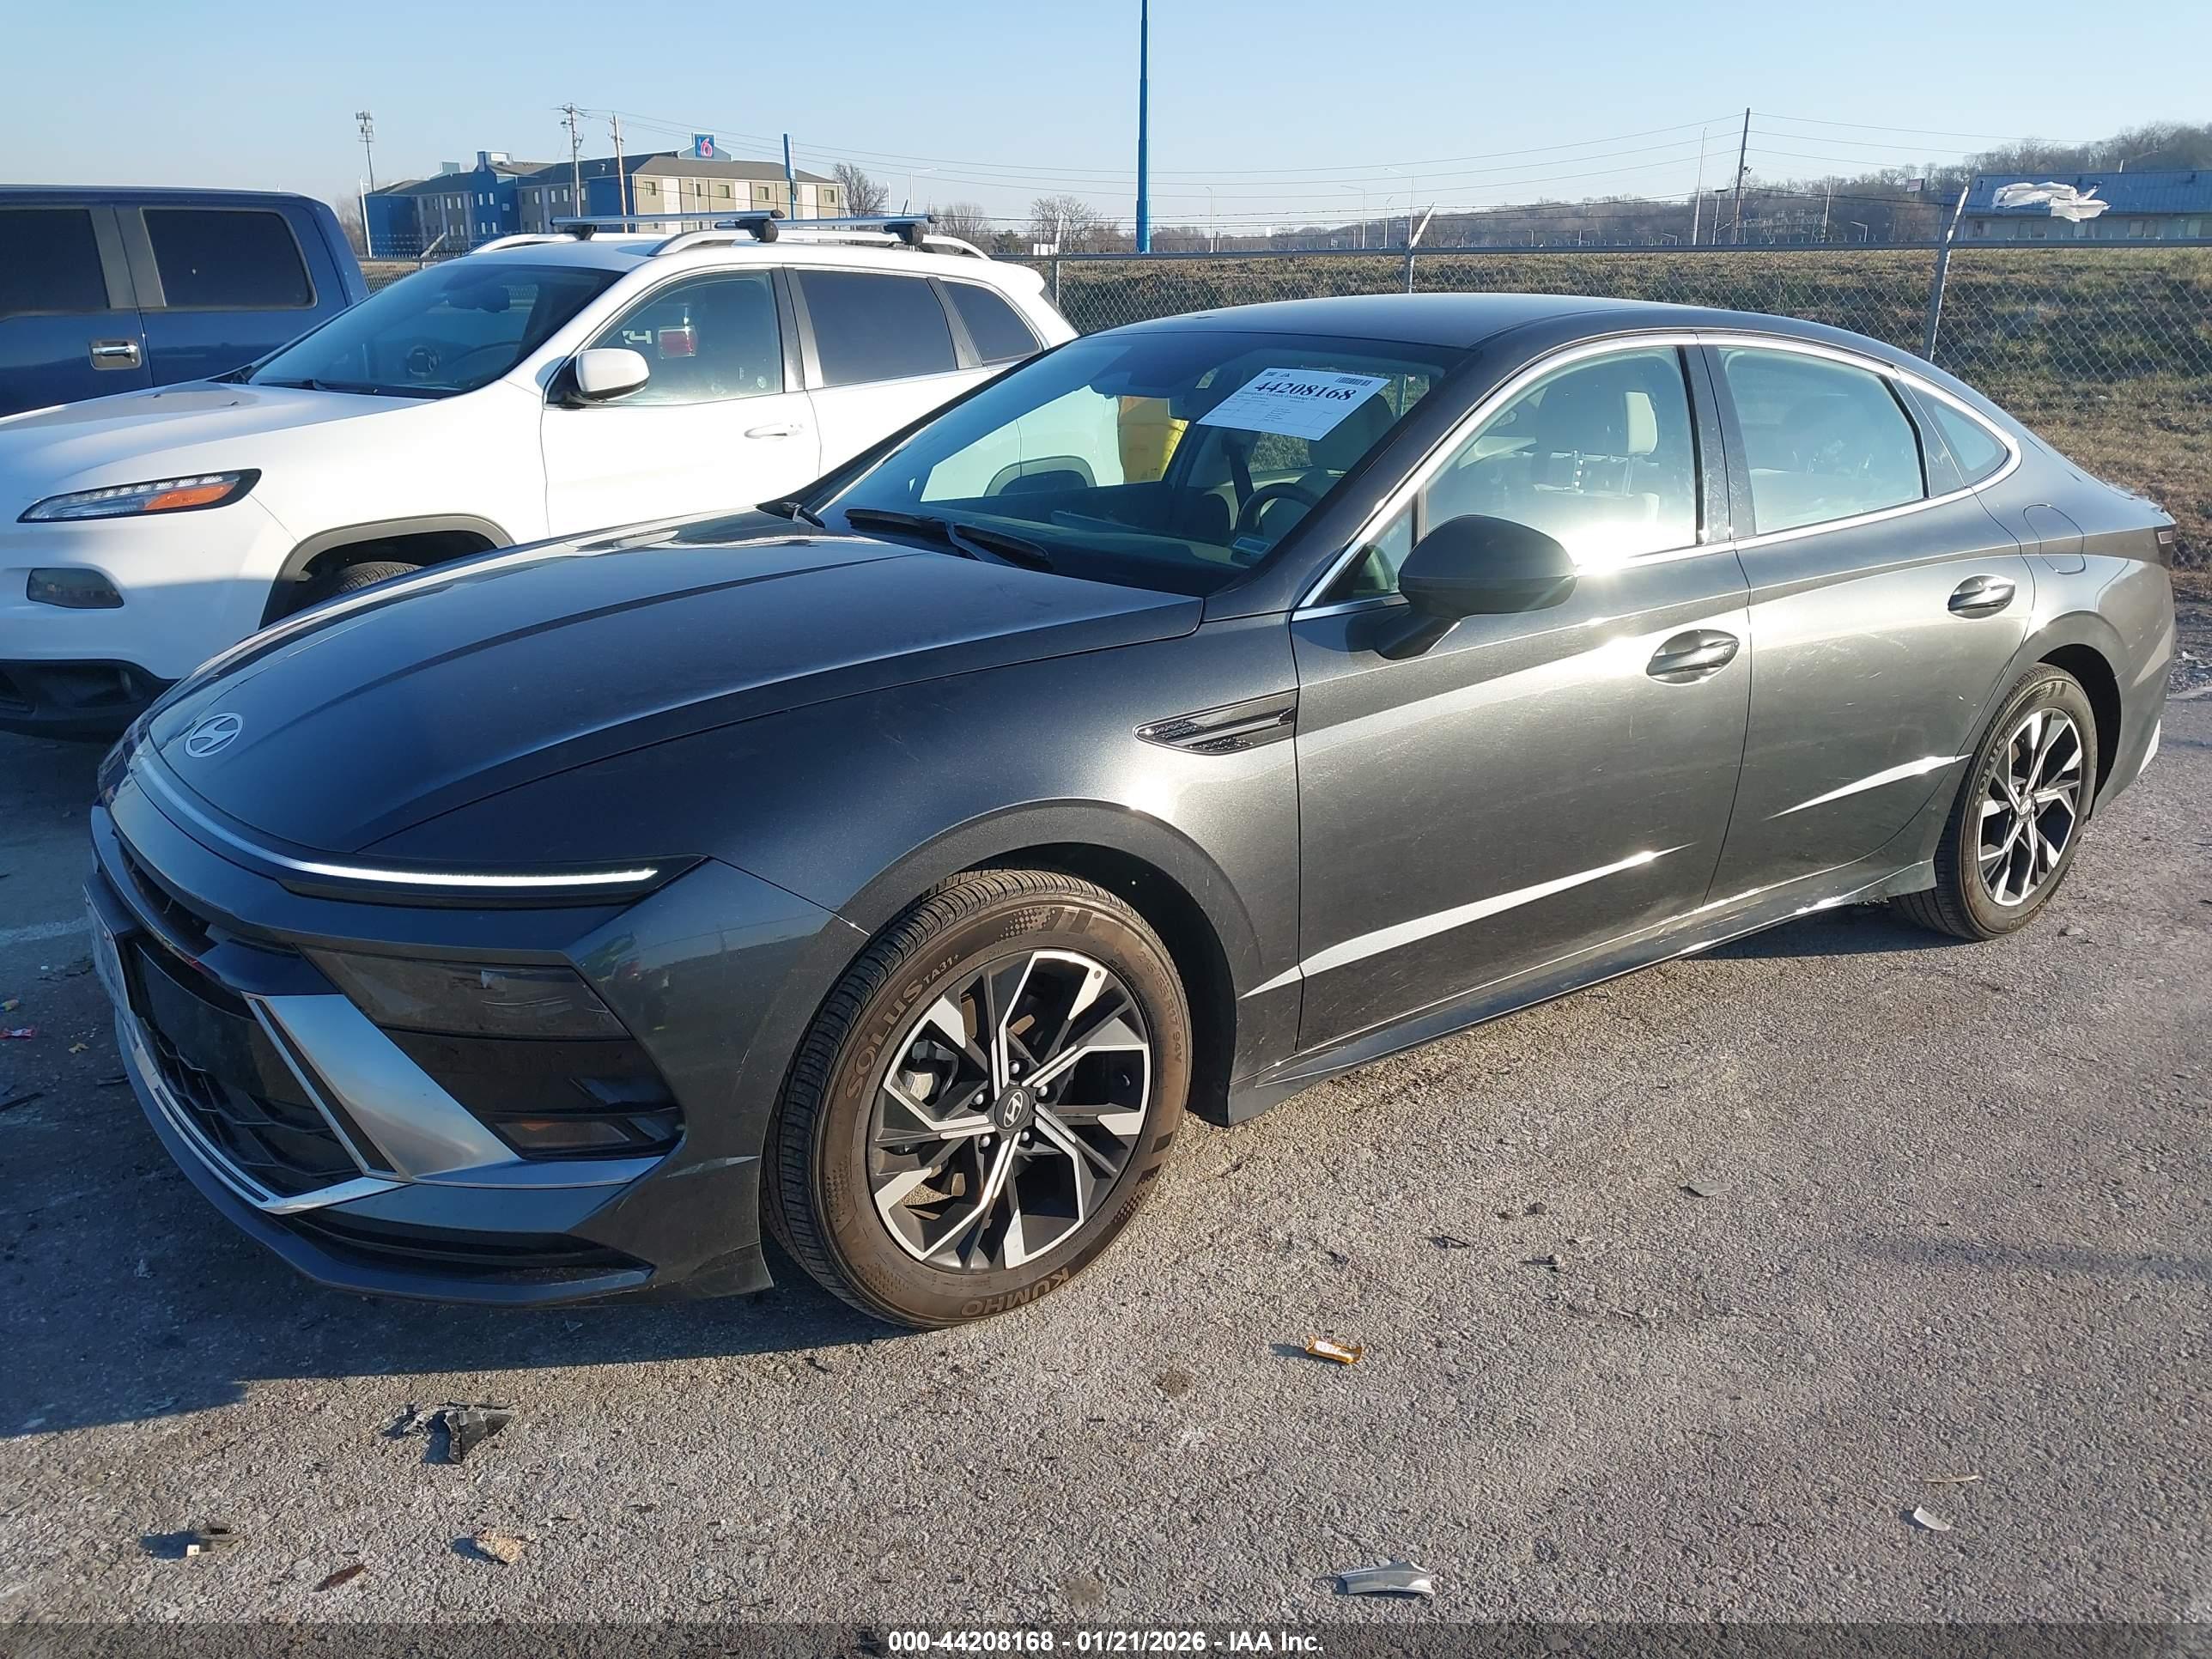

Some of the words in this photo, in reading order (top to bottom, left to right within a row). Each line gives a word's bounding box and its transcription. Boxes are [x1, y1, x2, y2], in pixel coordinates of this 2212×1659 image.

[701, 137, 713, 157] 6
[1255, 381, 1357, 401] 44208168
[846, 979, 923, 1099] SOLUS
[961, 1267, 1070, 1316] KUMHO
